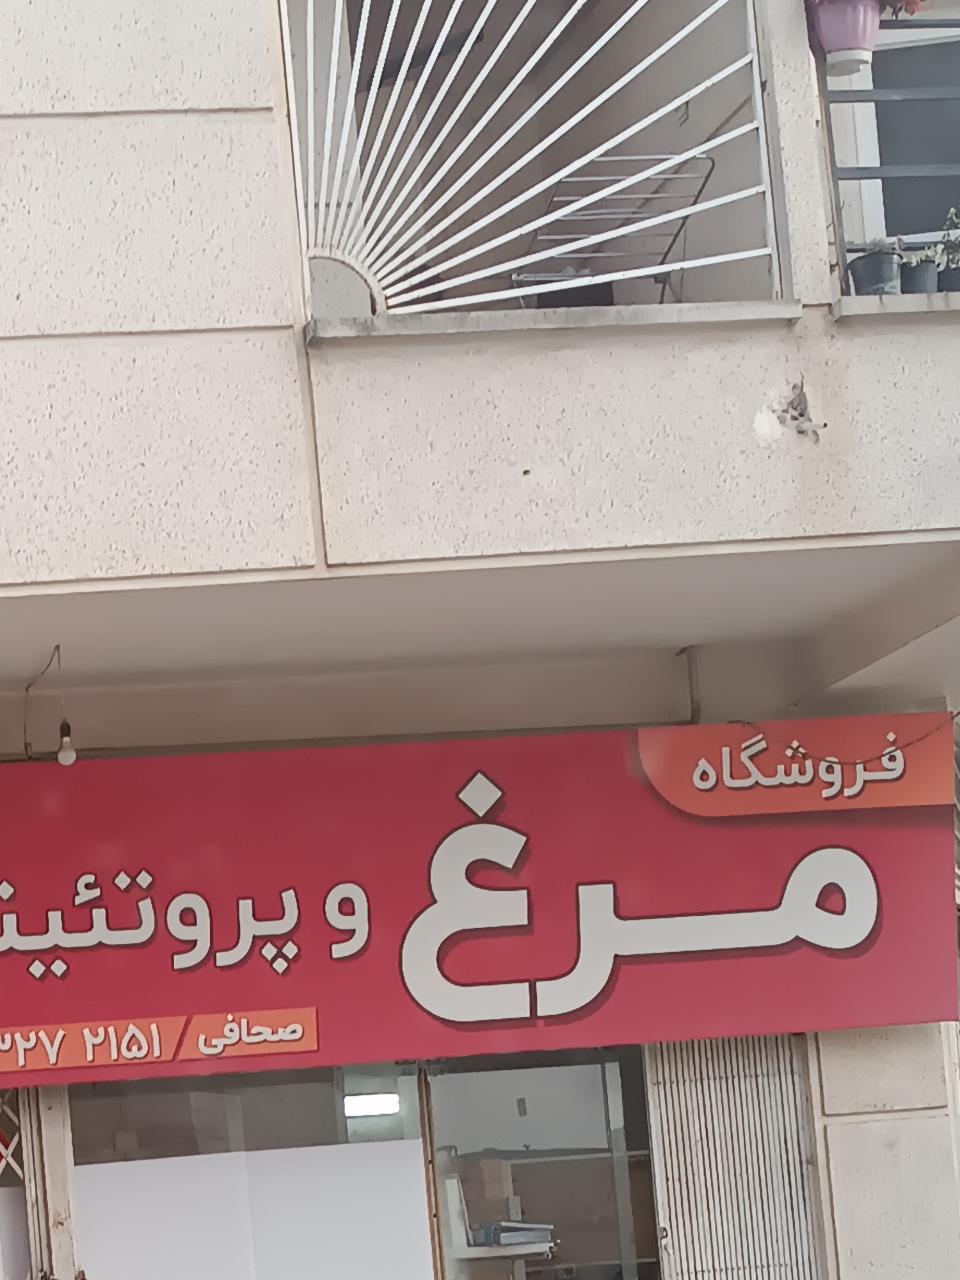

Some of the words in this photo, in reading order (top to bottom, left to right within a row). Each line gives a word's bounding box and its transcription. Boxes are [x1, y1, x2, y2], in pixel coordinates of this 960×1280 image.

[692, 731, 905, 799] فروشگاه
[324, 881, 370, 959] و
[402, 771, 878, 1023] مرغ
[82, 1022, 162, 1062] ۲۱۵۱
[197, 1013, 304, 1056] صحافی
